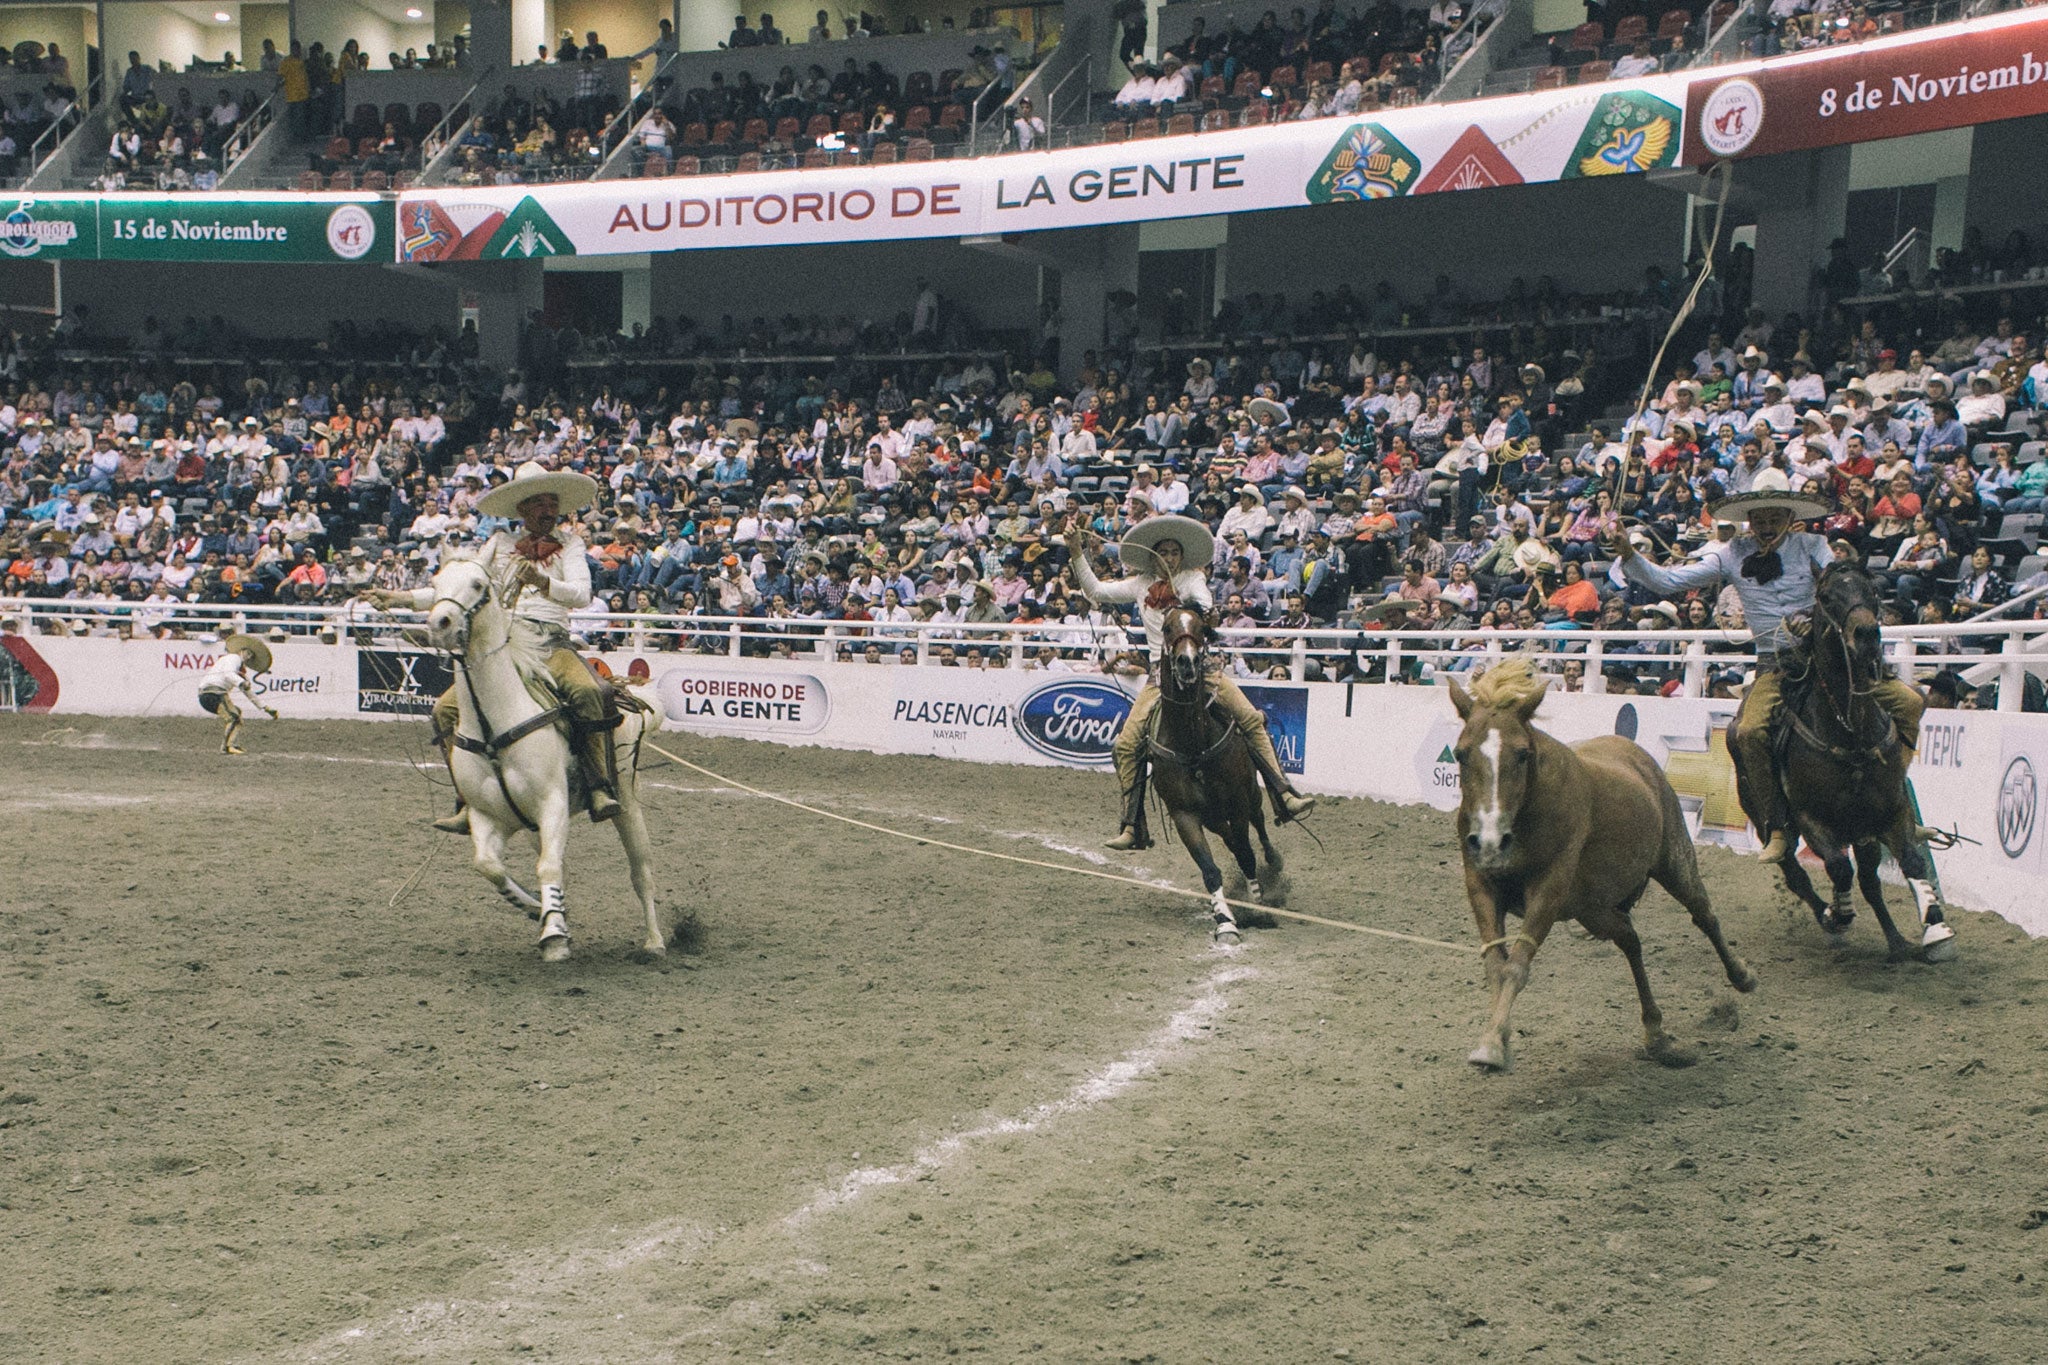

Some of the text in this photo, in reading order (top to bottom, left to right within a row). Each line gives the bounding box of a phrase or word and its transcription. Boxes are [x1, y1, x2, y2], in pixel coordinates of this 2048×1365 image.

[1819, 88, 1837, 117] 8
[1845, 80, 1883, 113] de
[608, 154, 1245, 235] AUDITORIO DE LA GENTE
[113, 218, 288, 242] 15 de Noviembre
[165, 653, 226, 670] NAYA
[252, 671, 320, 695] Suerte!
[681, 678, 806, 701] GOBIERNO DE
[685, 698, 801, 722] LA GENTE
[894, 700, 1008, 728] PLASENCIA
[1044, 693, 1122, 746] Ford
[932, 730, 968, 741] NAYARIT
[1926, 725, 1965, 767] TEPIC
[1432, 767, 1462, 788] Sier
